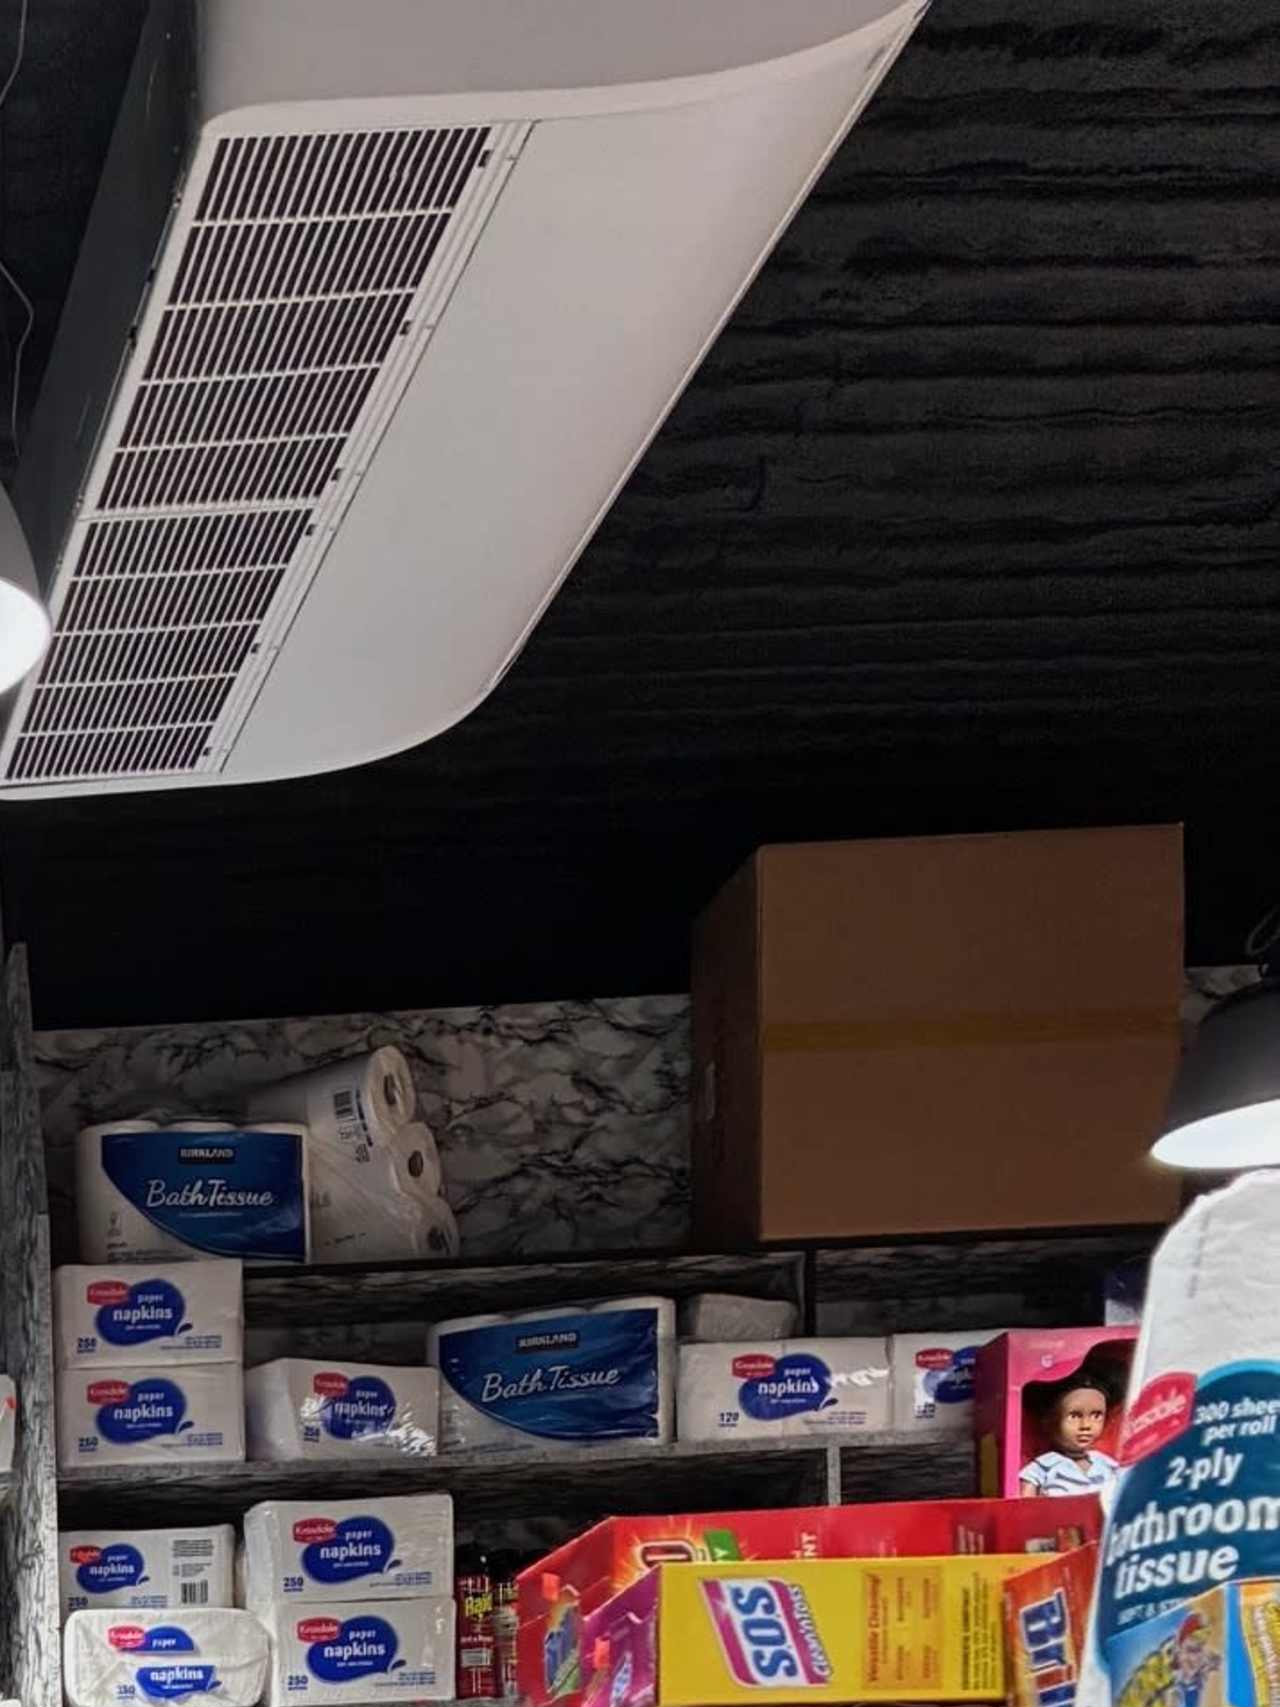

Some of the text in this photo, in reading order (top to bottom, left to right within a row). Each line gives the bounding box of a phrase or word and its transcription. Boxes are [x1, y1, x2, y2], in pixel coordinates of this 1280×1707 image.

[146, 1179, 275, 1208] Bath Tissue
[113, 1308, 173, 1323] napkins
[482, 1363, 621, 1403] Bath Tissue
[757, 1379, 820, 1396] napkins
[114, 1406, 174, 1422] napkins
[1195, 1400, 1230, 1425] 300
[1204, 1414, 1277, 1446] per roll
[1164, 1447, 1244, 1490] 2-ply
[320, 1544, 382, 1561] napkins
[89, 1564, 135, 1576] napkins
[1114, 1543, 1239, 1600] tissue
[349, 1630, 377, 1642] paper
[324, 1643, 386, 1660] napkins
[149, 1668, 204, 1683] napkins
[288, 1675, 309, 1687] 250
